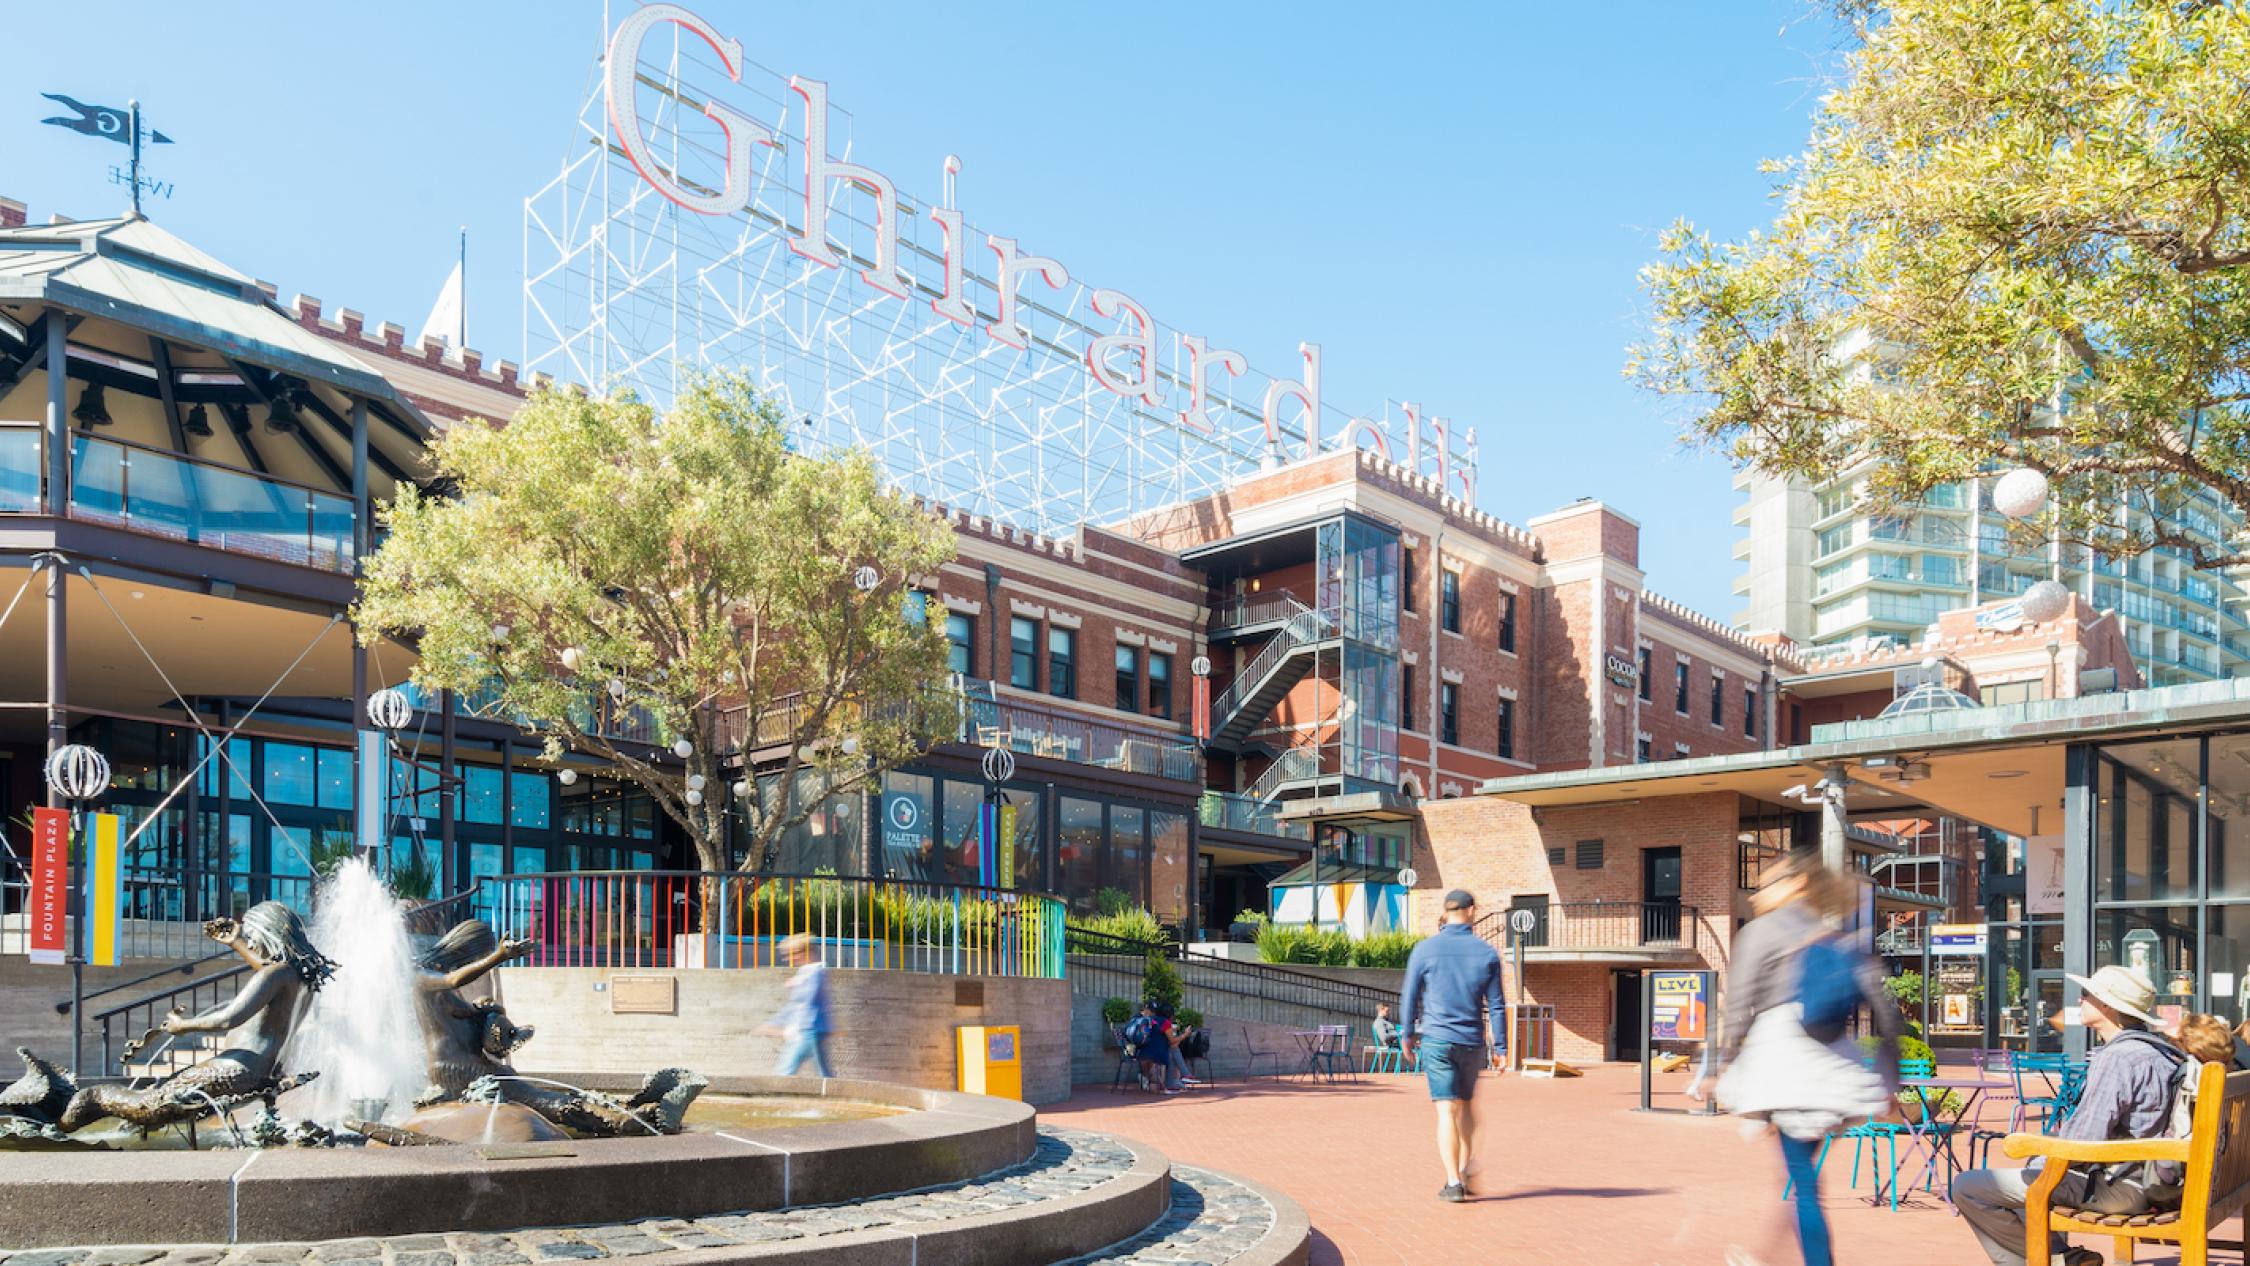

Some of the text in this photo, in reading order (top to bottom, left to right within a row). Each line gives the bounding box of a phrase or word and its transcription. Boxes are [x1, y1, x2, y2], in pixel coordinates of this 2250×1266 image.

[1608, 656, 1637, 678] COCOA
[46, 817, 58, 863] PLAZA
[887, 831, 920, 842] PALETTE
[43, 868, 56, 942] FOUNTAIN
[1658, 980, 1697, 990] LIVE
